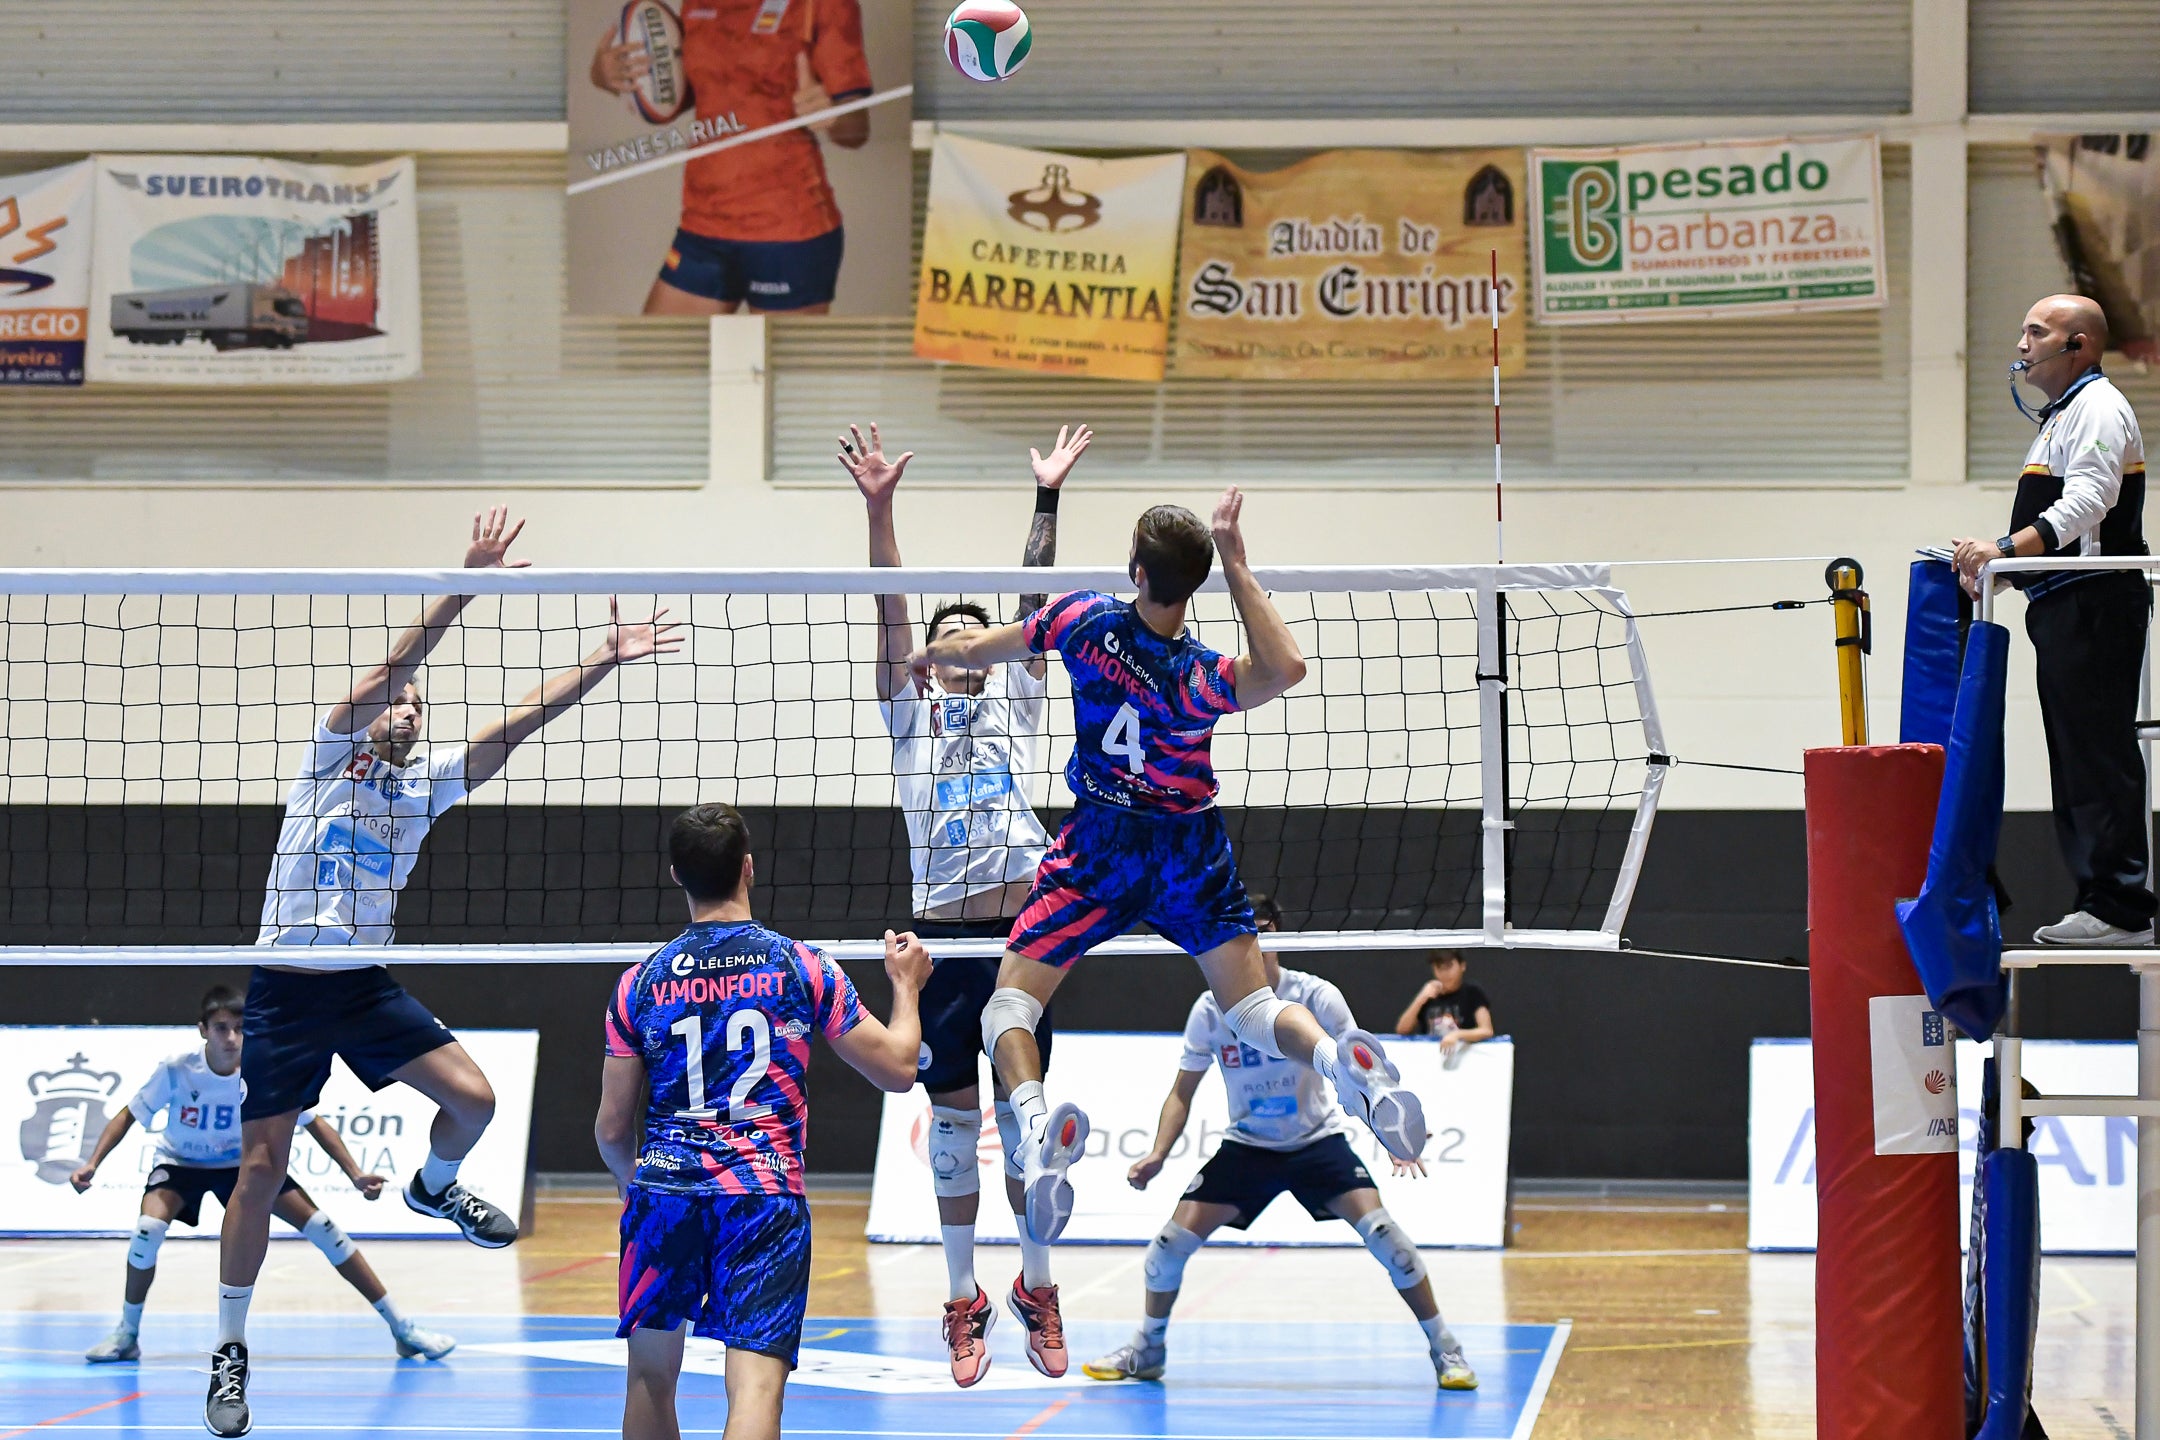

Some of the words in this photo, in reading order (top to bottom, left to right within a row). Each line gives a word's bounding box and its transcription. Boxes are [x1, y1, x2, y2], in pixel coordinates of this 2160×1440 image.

[586, 130, 681, 171] VANESA
[689, 111, 748, 143] RIAL
[1628, 151, 1829, 213] pesado
[971, 239, 1128, 275] CAFETERIA
[1270, 216, 1381, 255] Abadía
[1402, 220, 1437, 253] de
[1629, 212, 1837, 254] barbanza
[1630, 254, 1751, 272] SUMINISTROS
[1757, 253, 1767, 264] Y
[927, 267, 1165, 323] BARBANTIA
[1190, 262, 1300, 316] San
[1319, 264, 1516, 327] Enrique
[1101, 701, 1146, 775] 4
[652, 971, 787, 1006] V.MONFORT
[670, 1007, 774, 1121] 12
